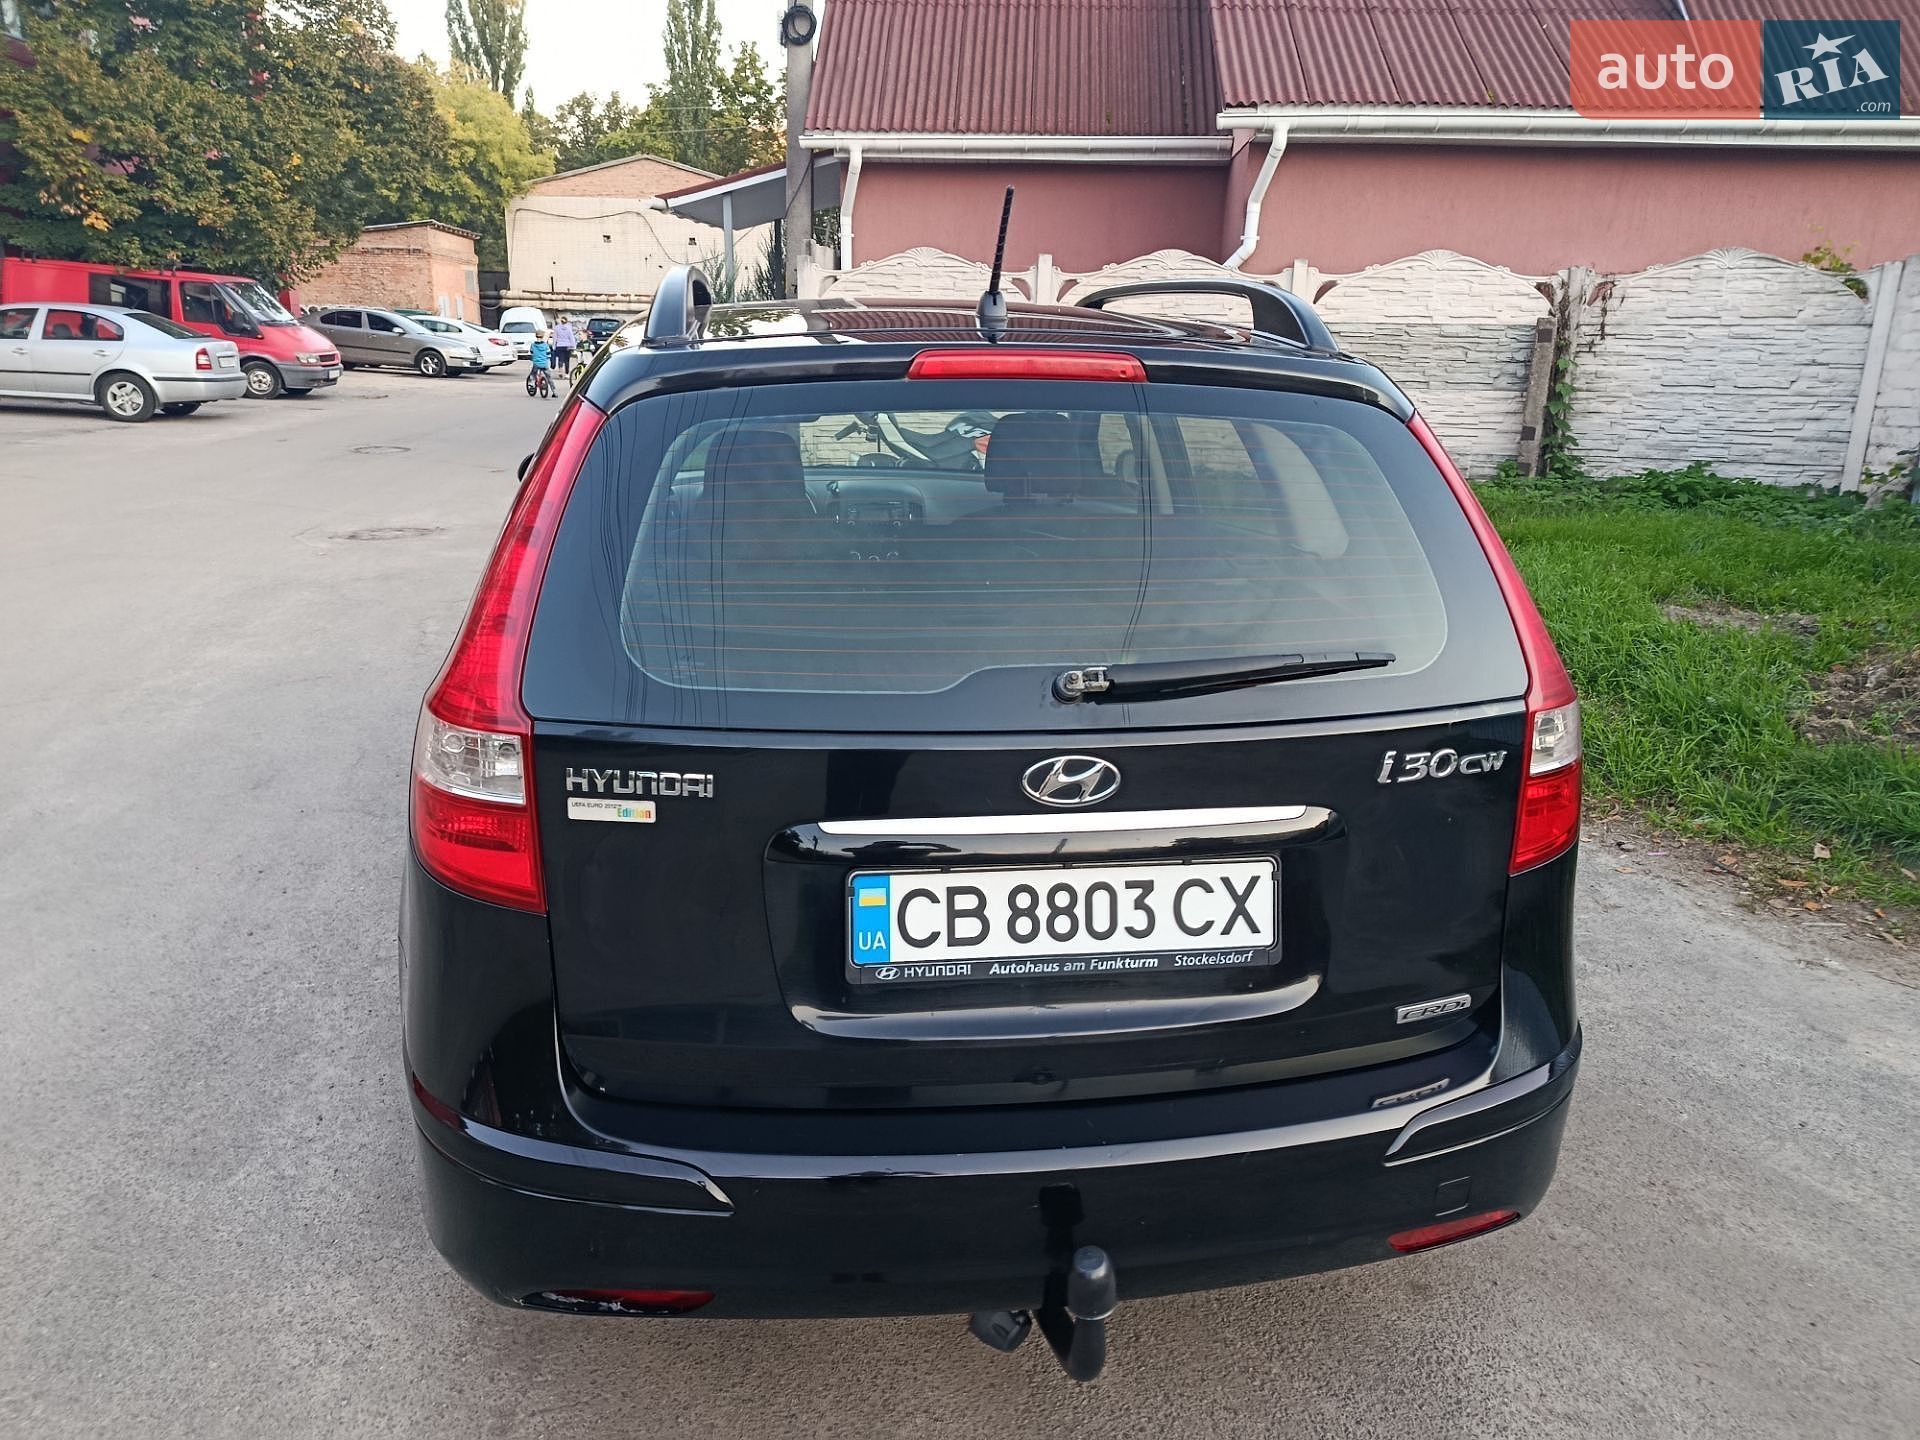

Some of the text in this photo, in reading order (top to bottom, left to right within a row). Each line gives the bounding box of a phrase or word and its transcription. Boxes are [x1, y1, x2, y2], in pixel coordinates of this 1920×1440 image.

[565, 767, 714, 798] HYUNDAI
[898, 875, 1261, 948] CB 8803 CX
[858, 931, 887, 951] UA
[904, 951, 1254, 978] HYUNDAI Autohaus am Funkturm Stockelsdorf
